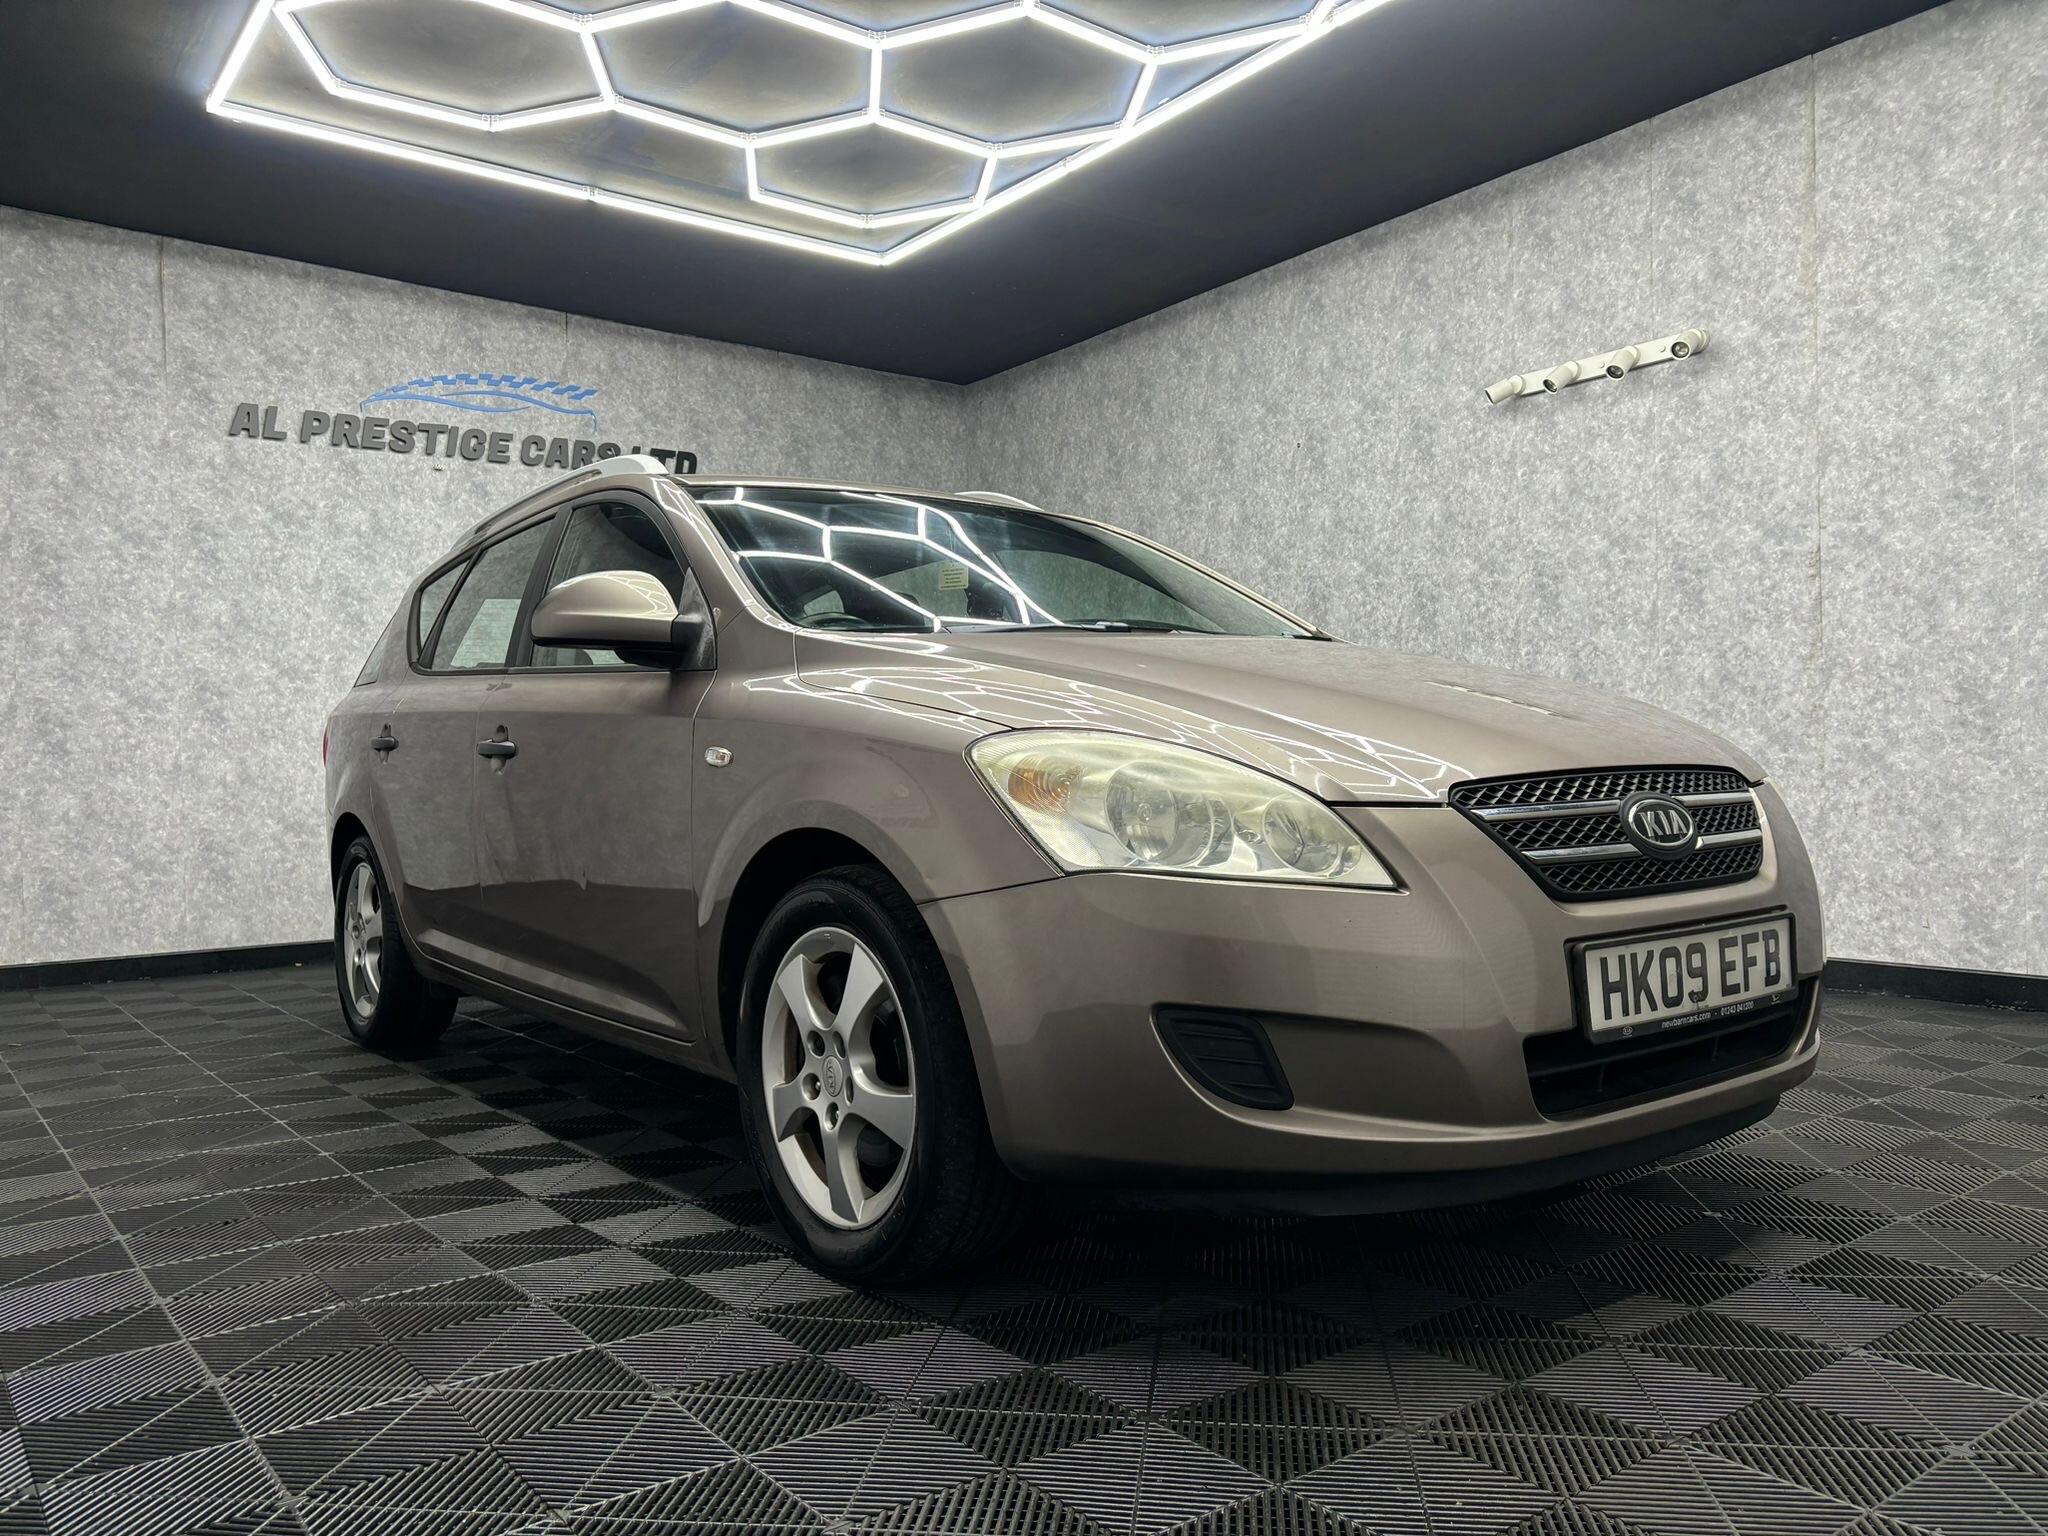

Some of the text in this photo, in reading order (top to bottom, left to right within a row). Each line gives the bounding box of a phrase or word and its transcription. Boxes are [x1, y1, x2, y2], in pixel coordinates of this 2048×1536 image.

[228, 402, 288, 441] AL
[299, 410, 514, 465] PRESTIGE
[631, 446, 698, 475] TD
[1637, 809, 1688, 837] KIA
[1599, 928, 1782, 1021] HK09 EFB
